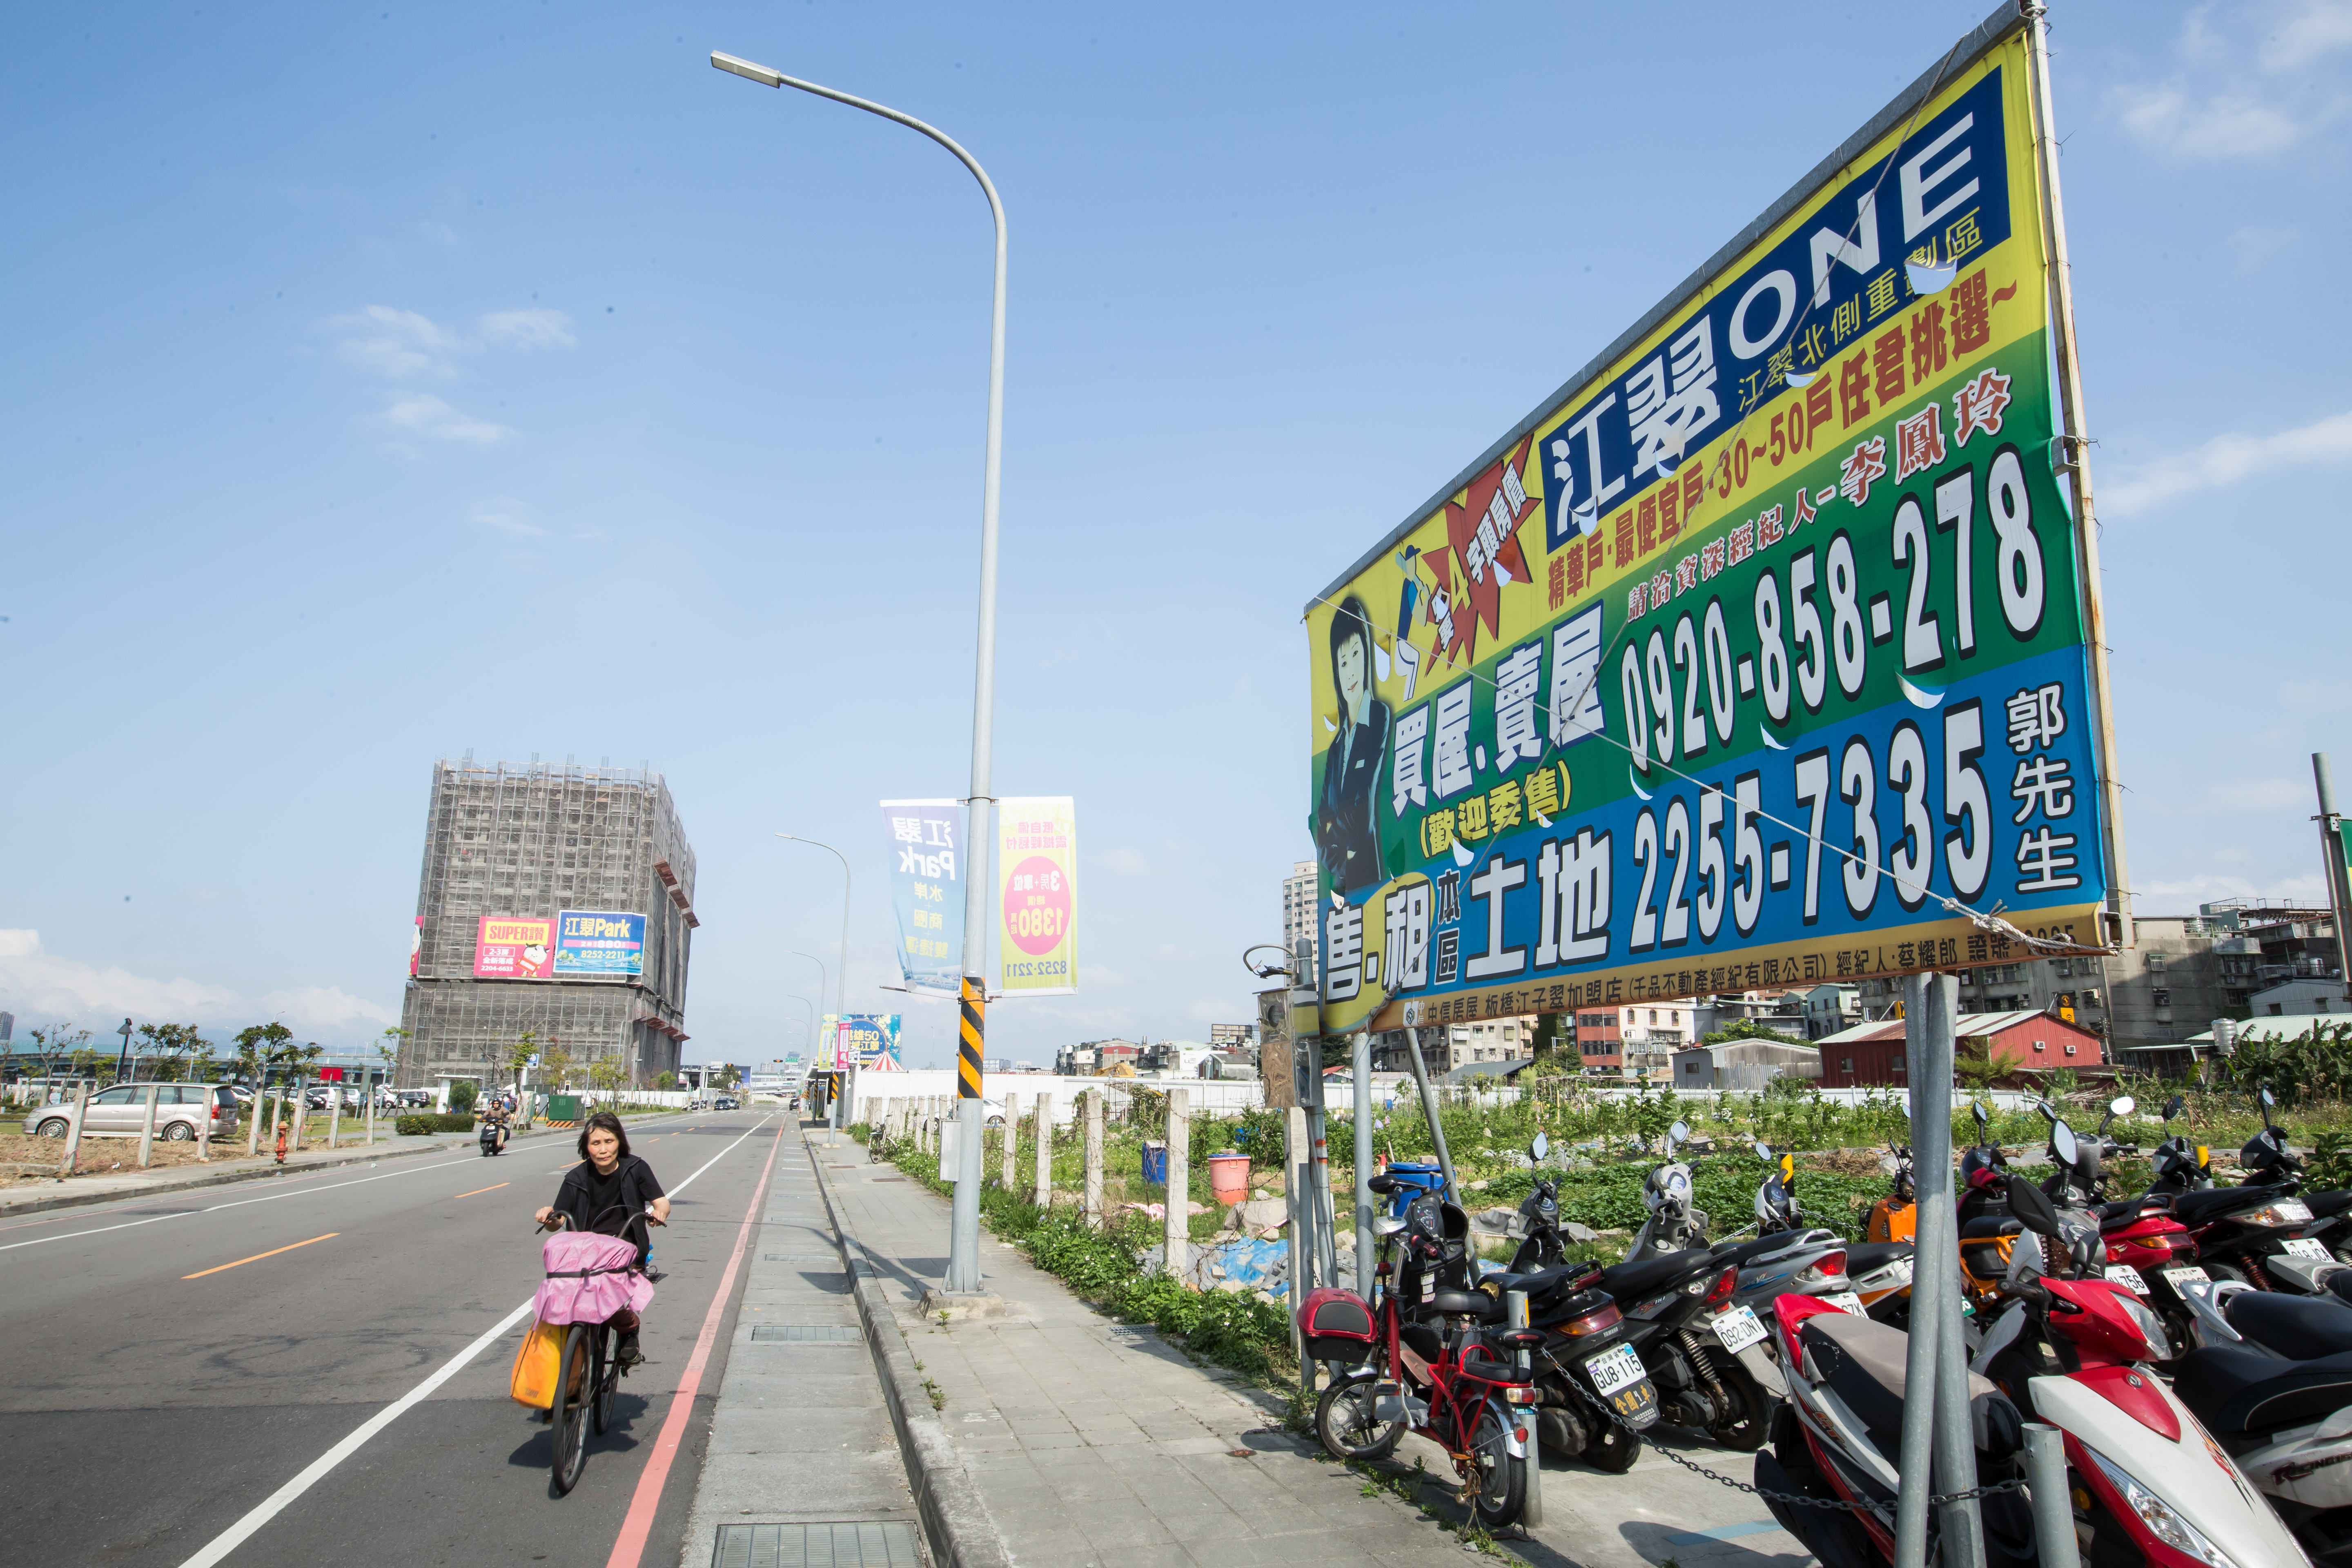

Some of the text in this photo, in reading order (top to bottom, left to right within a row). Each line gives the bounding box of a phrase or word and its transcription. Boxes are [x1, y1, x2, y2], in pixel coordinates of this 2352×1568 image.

[1619, 442, 2048, 778] 0920-858-278
[2005, 684, 2080, 896] 郭先生
[1629, 694, 1997, 960] 2255-7335
[1464, 825, 1613, 984] 土地
[489, 925, 546, 941] SUPER讚
[564, 917, 630, 938] 江翠Park
[1434, 868, 1461, 985] 本區
[483, 957, 514, 965] 全新落成
[489, 948, 510, 956] 2-3房
[581, 950, 625, 959] 8252-2211
[1427, 996, 1478, 1023] 中信房屋
[1485, 976, 1621, 1017] 板橋江子翠加盟店
[1603, 1326, 1618, 1338] YAMAHA
